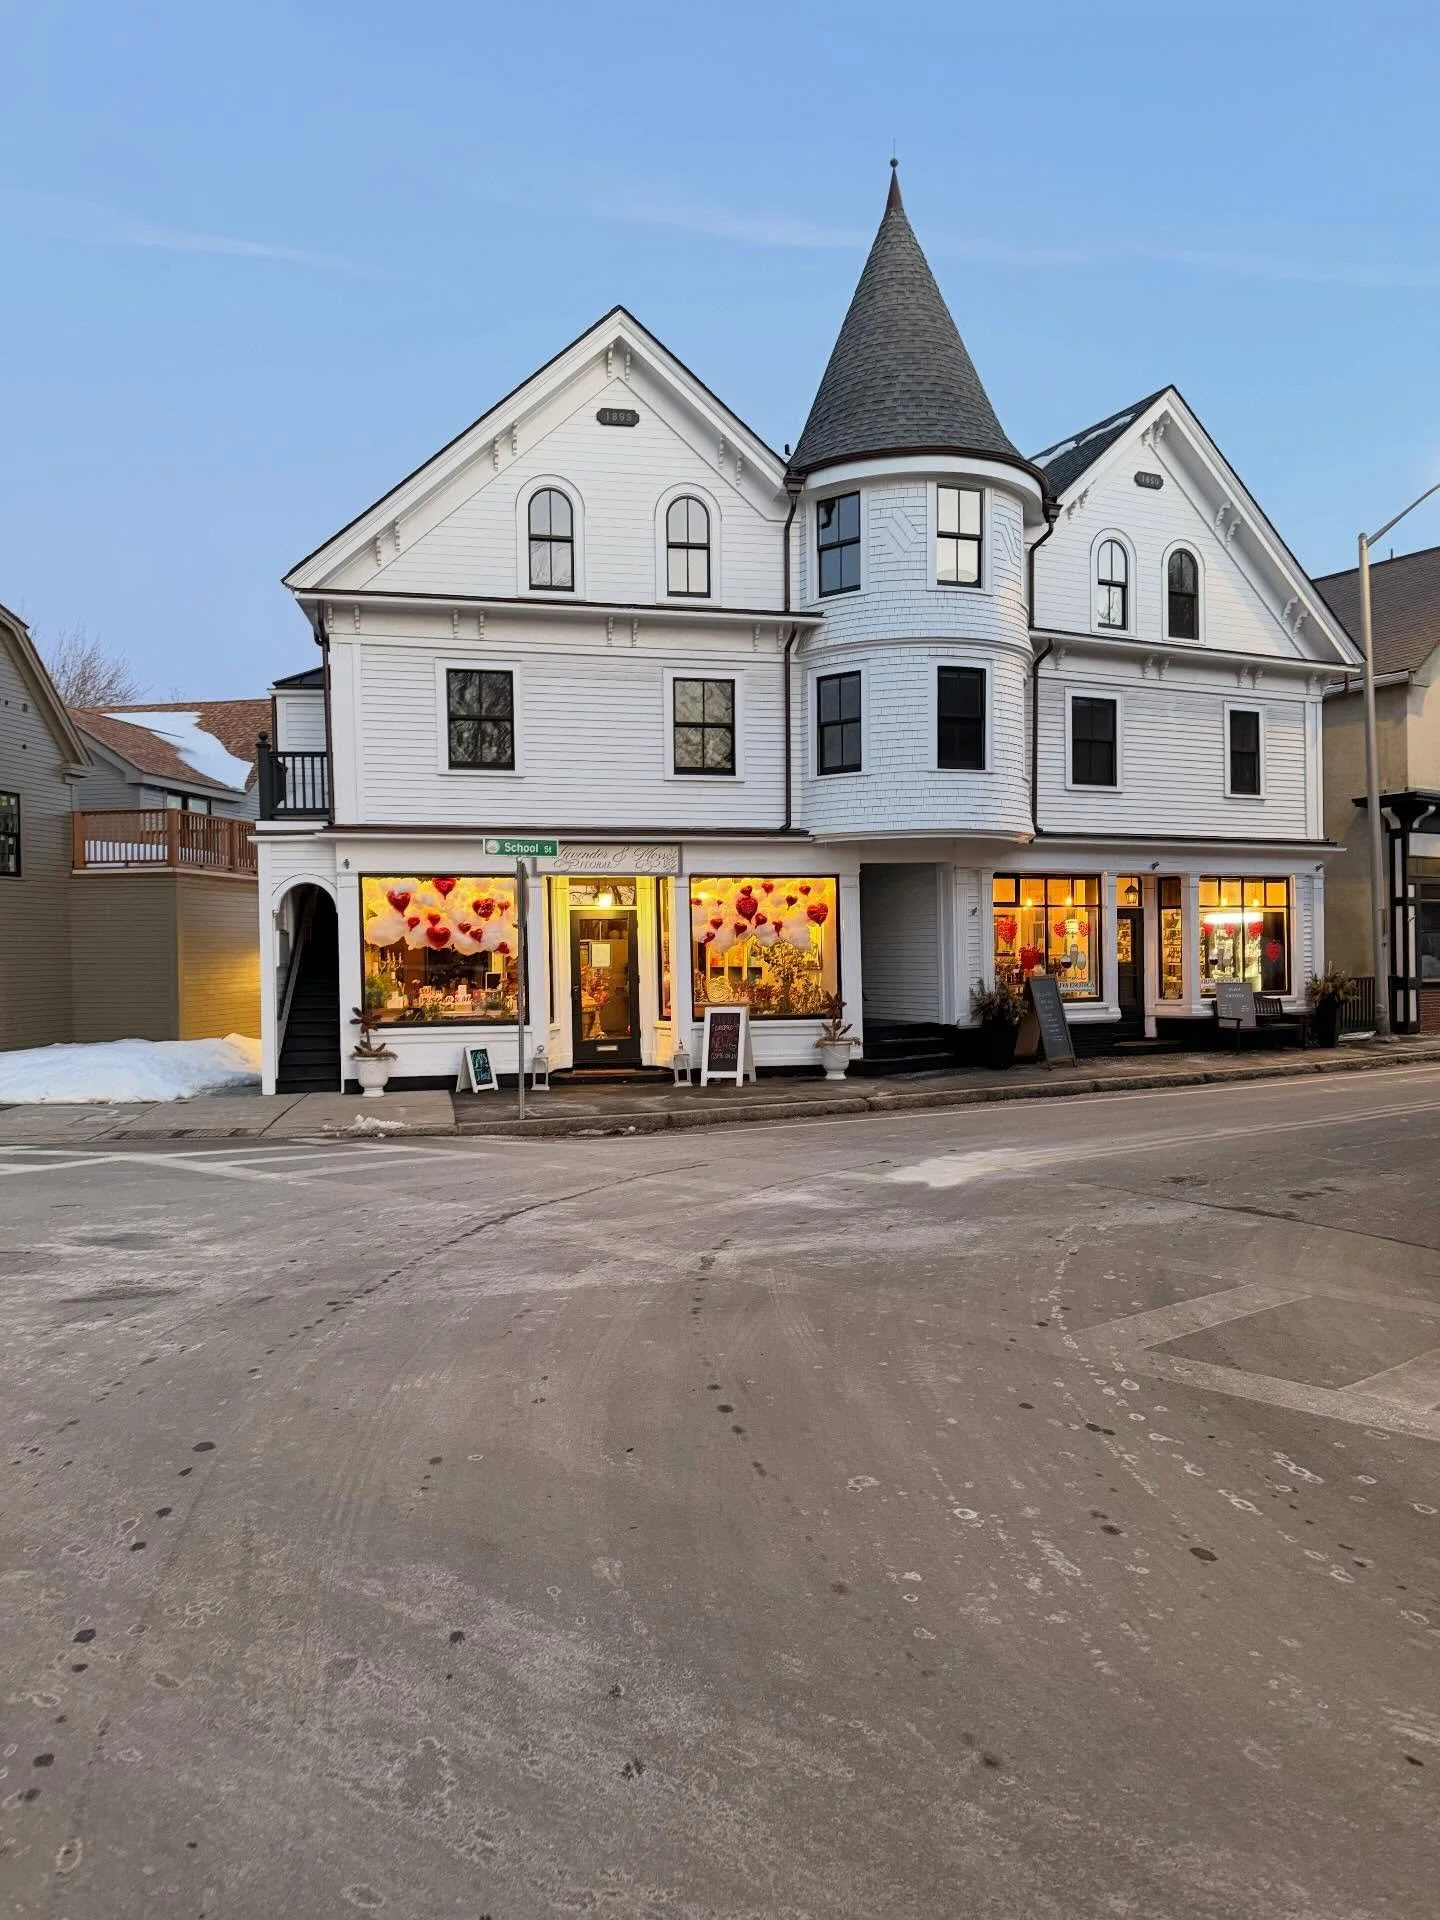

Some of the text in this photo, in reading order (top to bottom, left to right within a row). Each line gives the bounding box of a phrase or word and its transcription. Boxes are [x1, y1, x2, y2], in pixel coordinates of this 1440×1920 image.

[504, 842, 552, 853] School St
[554, 845, 608, 864] Lavender
[612, 845, 630, 862] &
[579, 860, 612, 869] FLORAL
